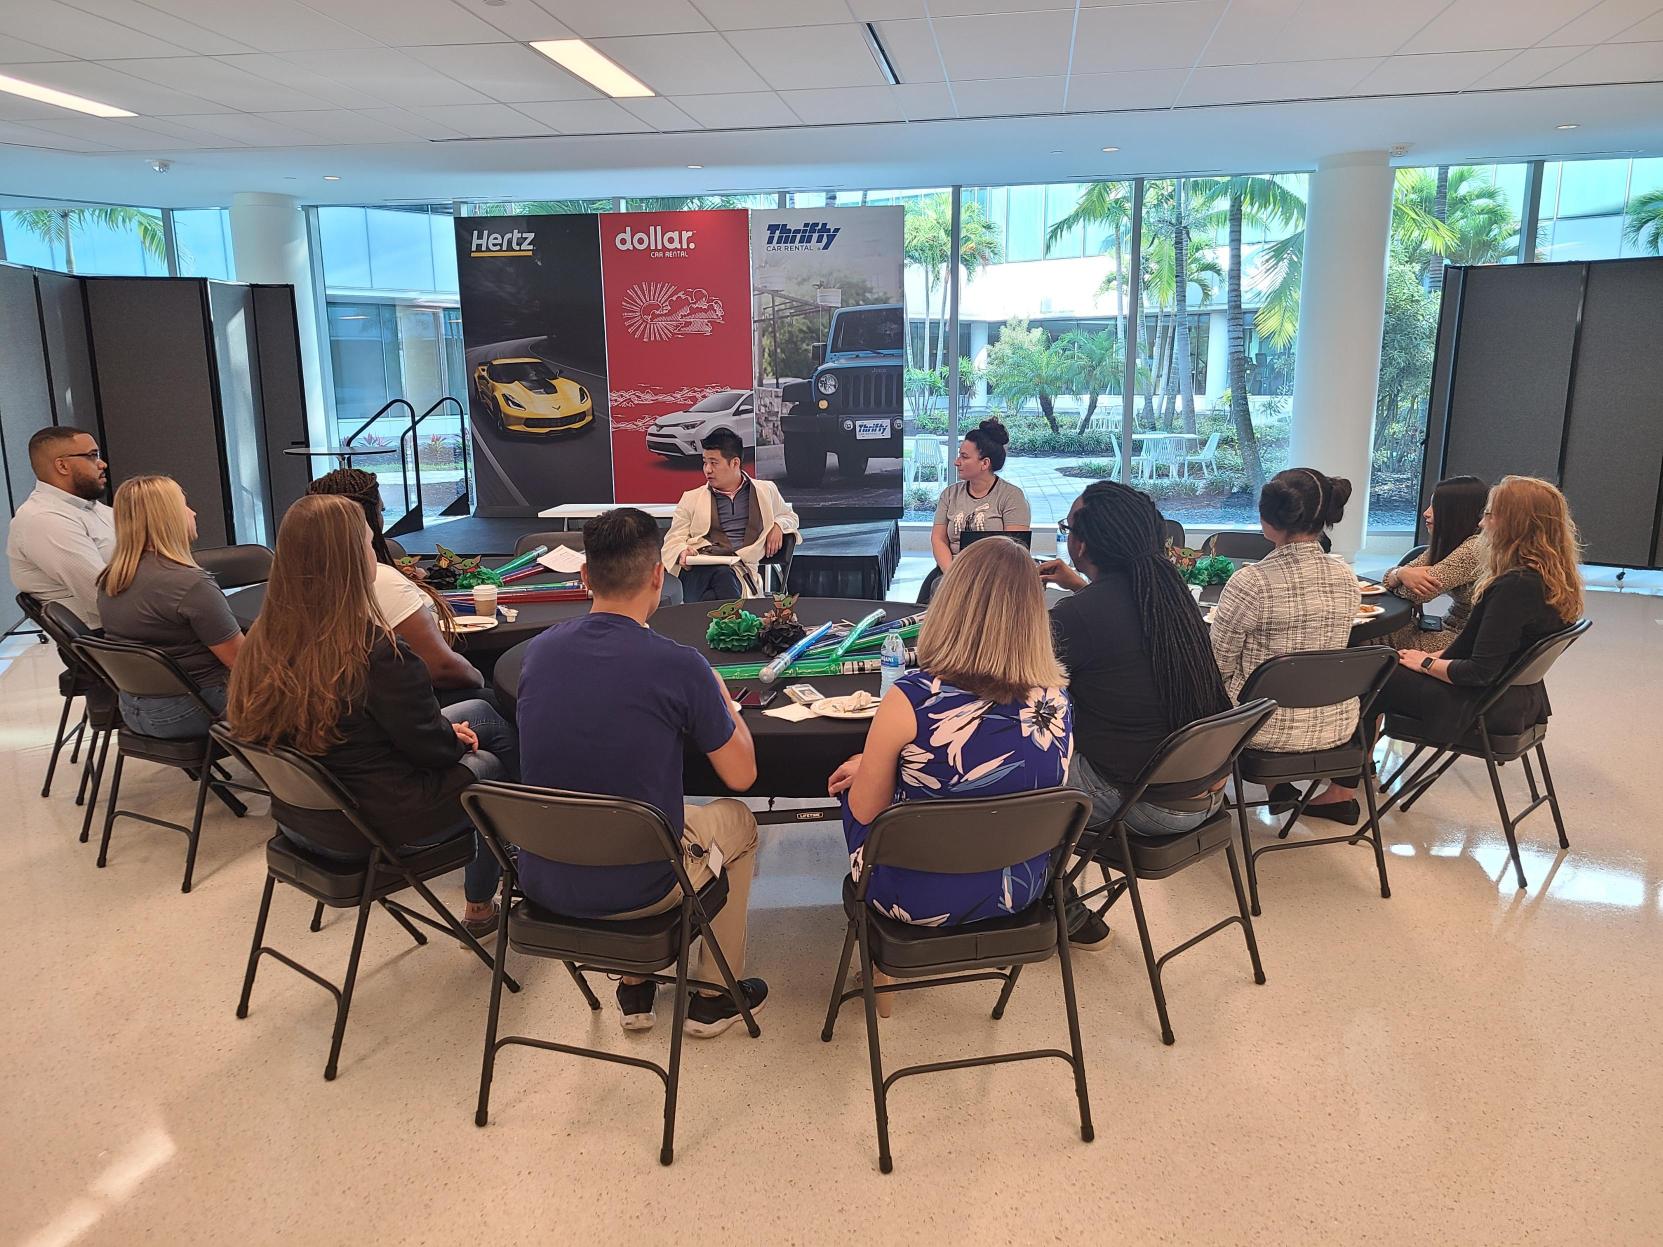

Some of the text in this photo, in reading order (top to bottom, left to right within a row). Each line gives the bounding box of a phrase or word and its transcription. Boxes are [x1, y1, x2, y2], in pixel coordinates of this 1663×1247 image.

[471, 229, 536, 251] Hertz
[767, 222, 841, 251] Thrifty
[665, 250, 689, 258] RENTAL
[784, 244, 814, 252] RENTAL
[858, 423, 889, 435] Thrifty
